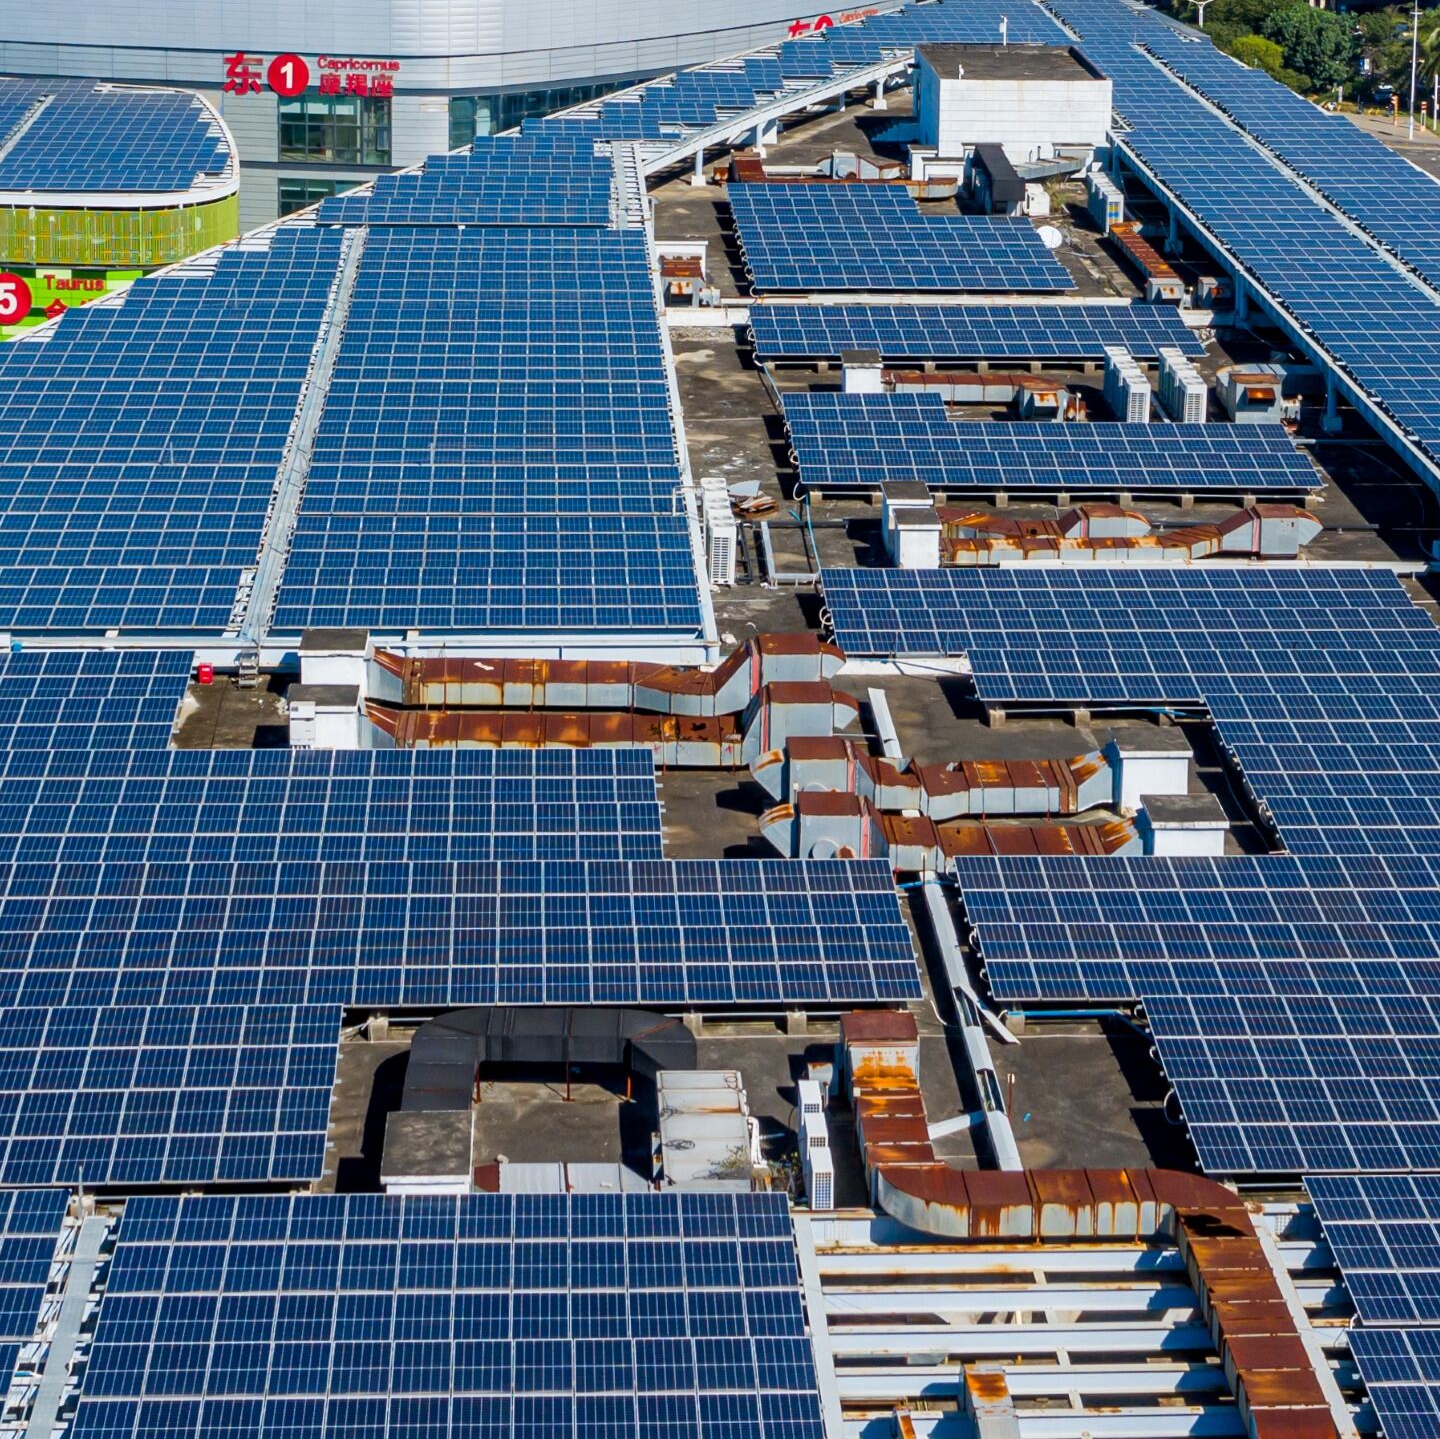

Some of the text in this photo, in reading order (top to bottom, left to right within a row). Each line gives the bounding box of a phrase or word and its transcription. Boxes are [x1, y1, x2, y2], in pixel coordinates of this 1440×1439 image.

[317, 55, 401, 73] Capricornus
[319, 72, 394, 98] 摩羯座
[44, 274, 105, 291] Taurus
